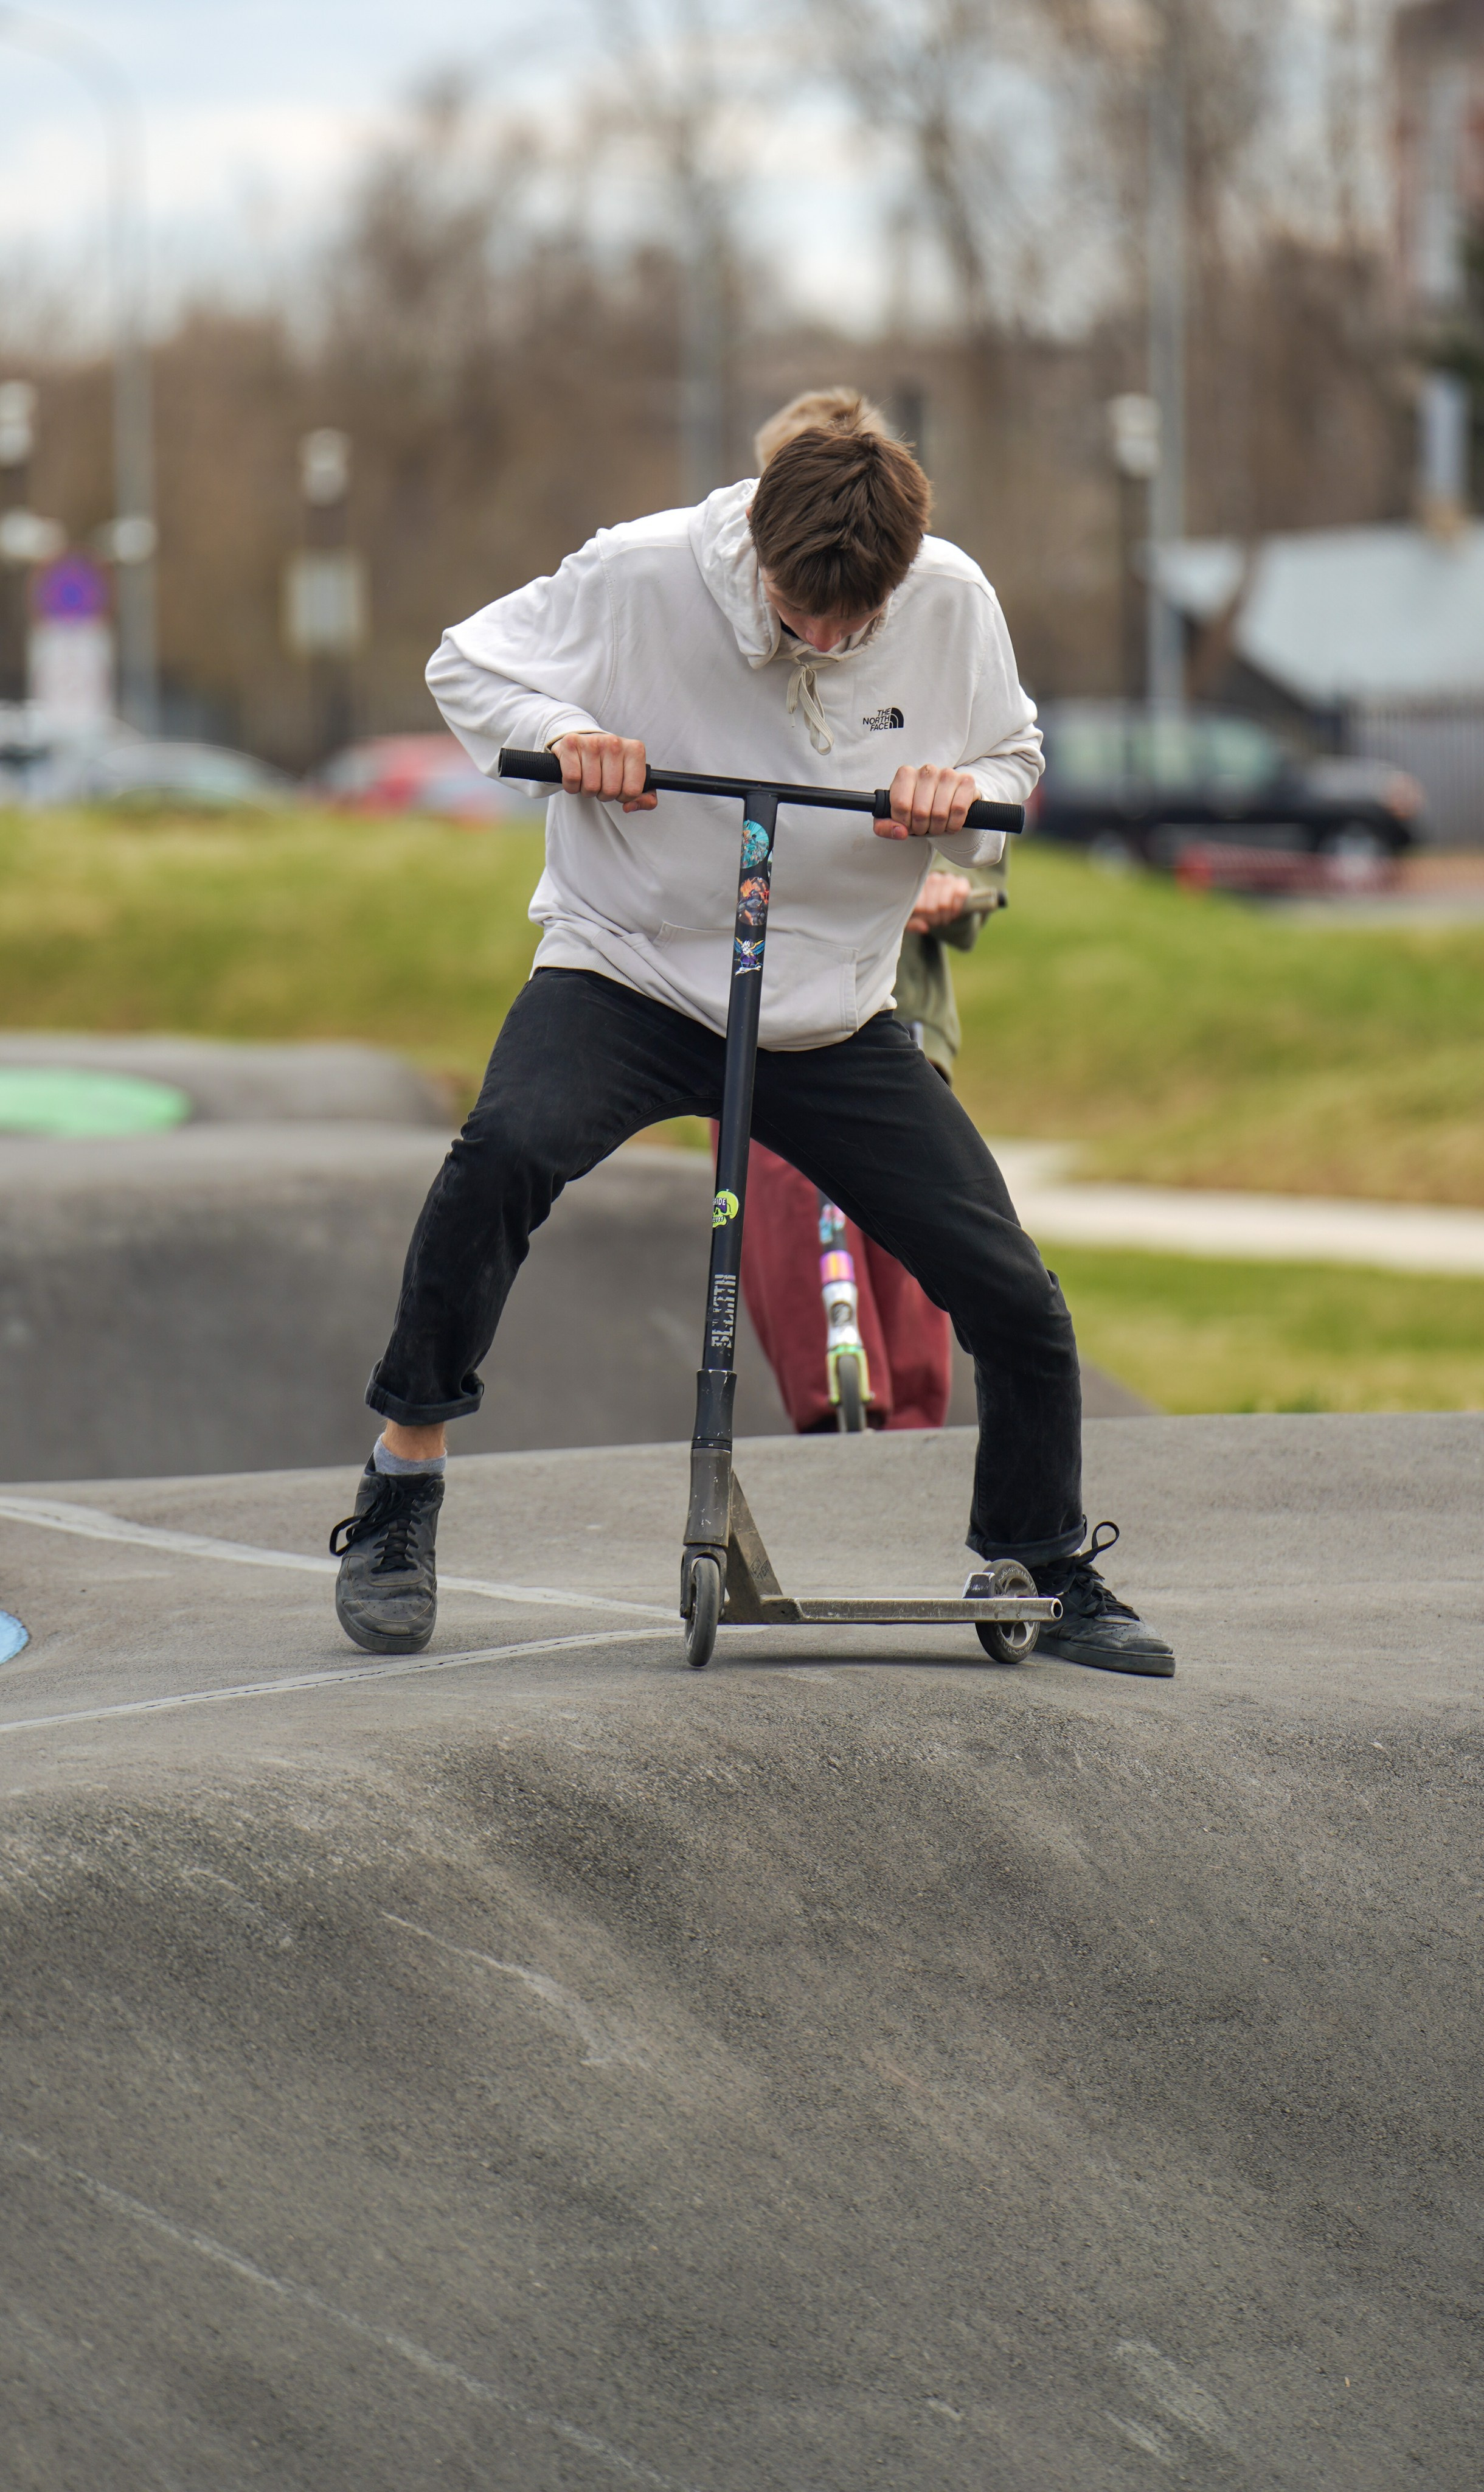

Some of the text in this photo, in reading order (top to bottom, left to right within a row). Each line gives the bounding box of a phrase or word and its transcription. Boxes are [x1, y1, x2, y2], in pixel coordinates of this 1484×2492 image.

[877, 708, 891, 717] THE
[862, 715, 890, 725] NORTH
[870, 722, 889, 731] FACE
